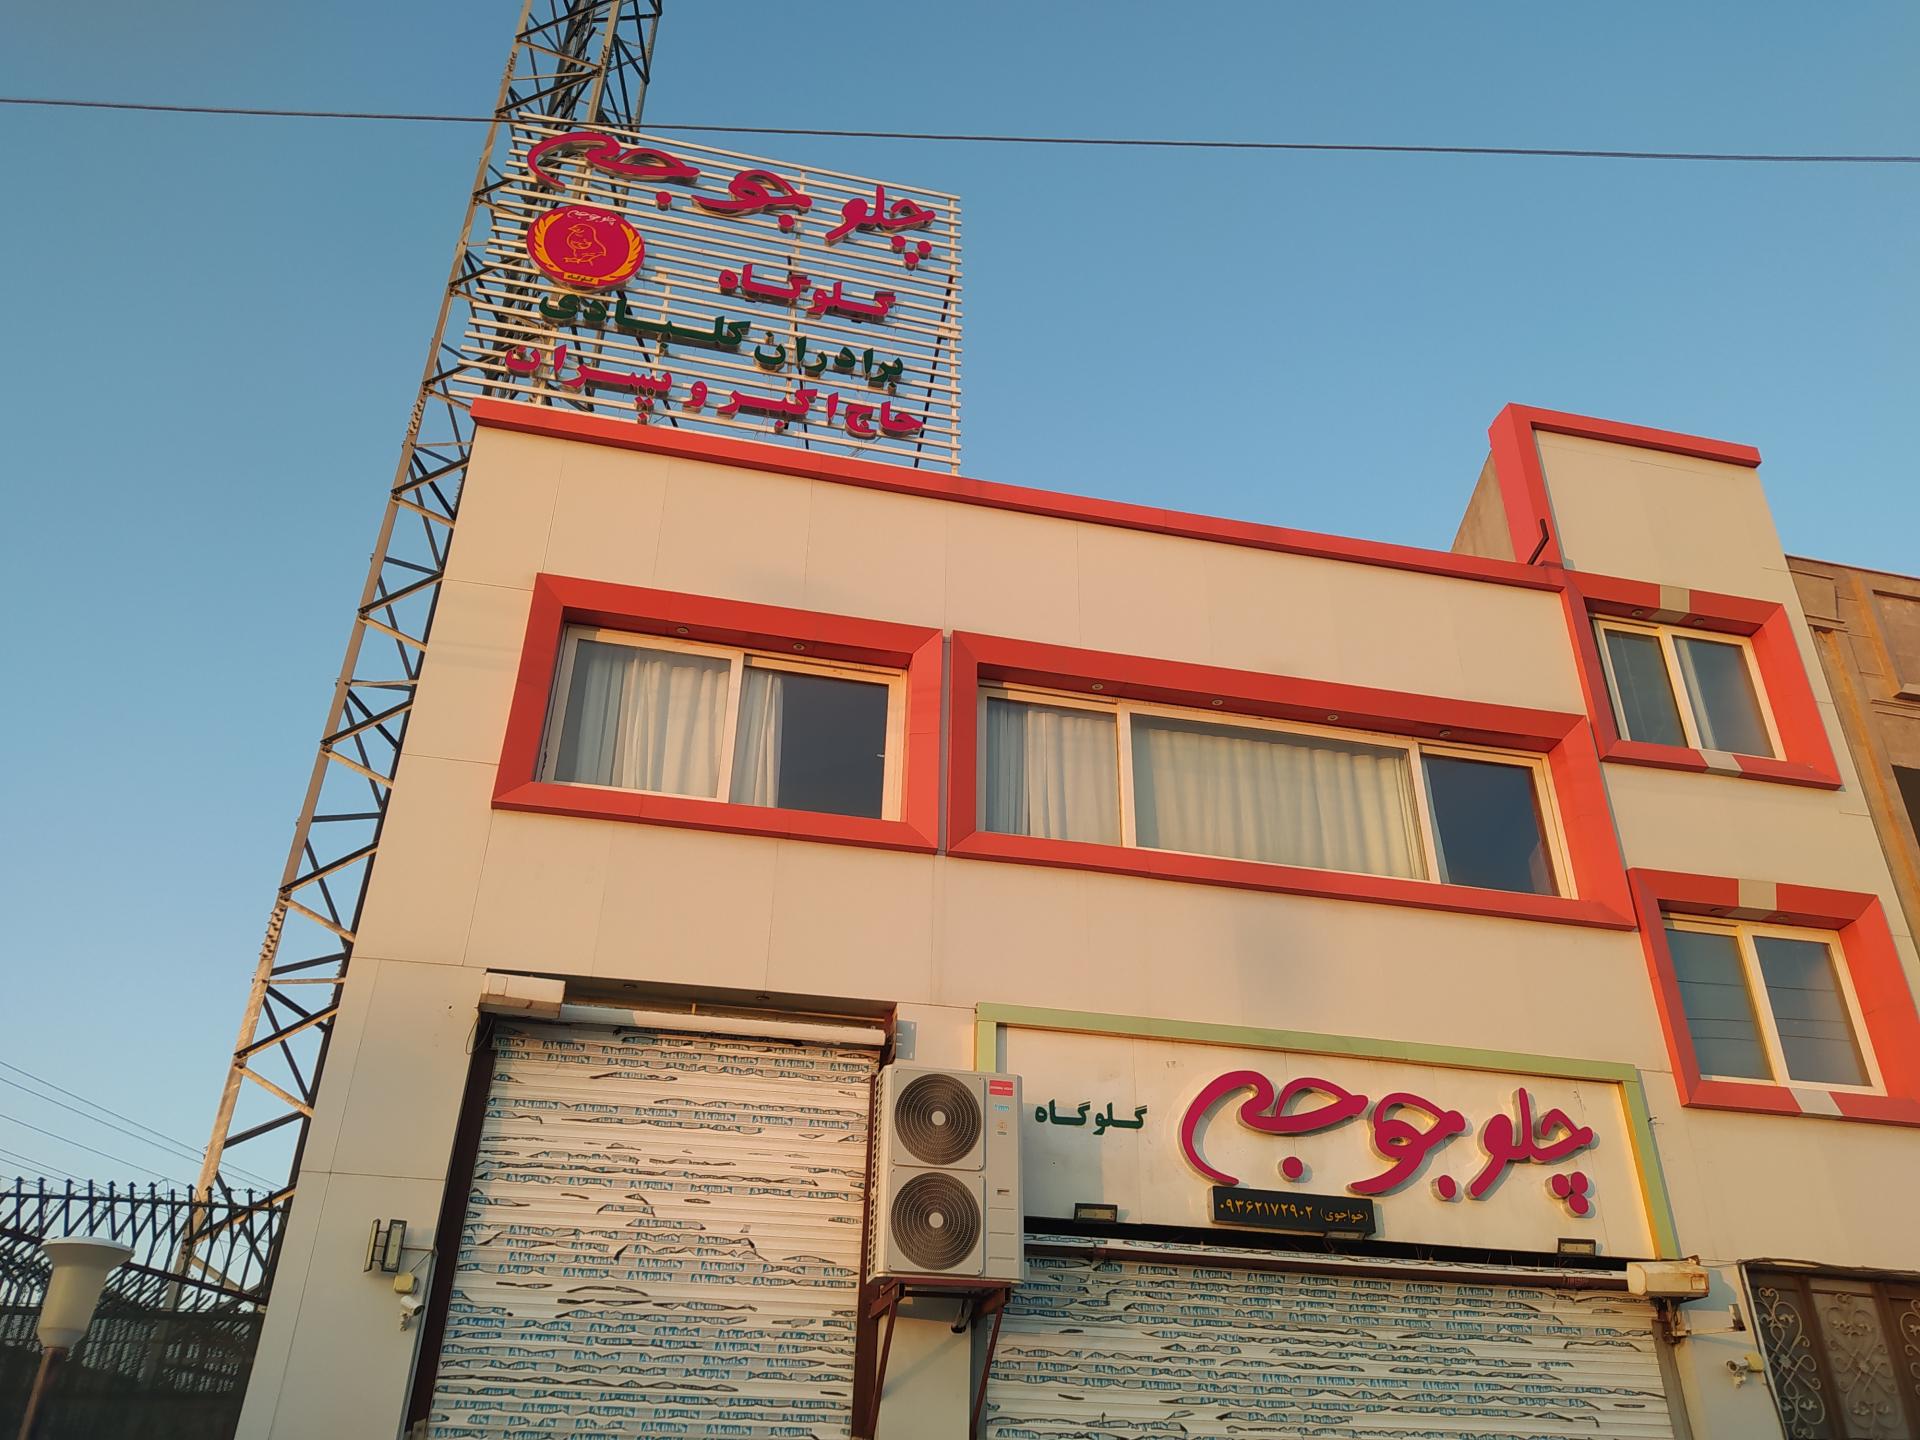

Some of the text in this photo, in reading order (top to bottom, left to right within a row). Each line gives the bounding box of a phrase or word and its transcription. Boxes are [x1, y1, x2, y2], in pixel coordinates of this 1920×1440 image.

[825, 184, 936, 269] چلو
[539, 294, 903, 393] برادران کلبادی
[505, 344, 924, 437] حاج اکبر و پسران
[1035, 1098, 1147, 1135] گلوگاه
[1465, 1087, 1593, 1216] چلو
